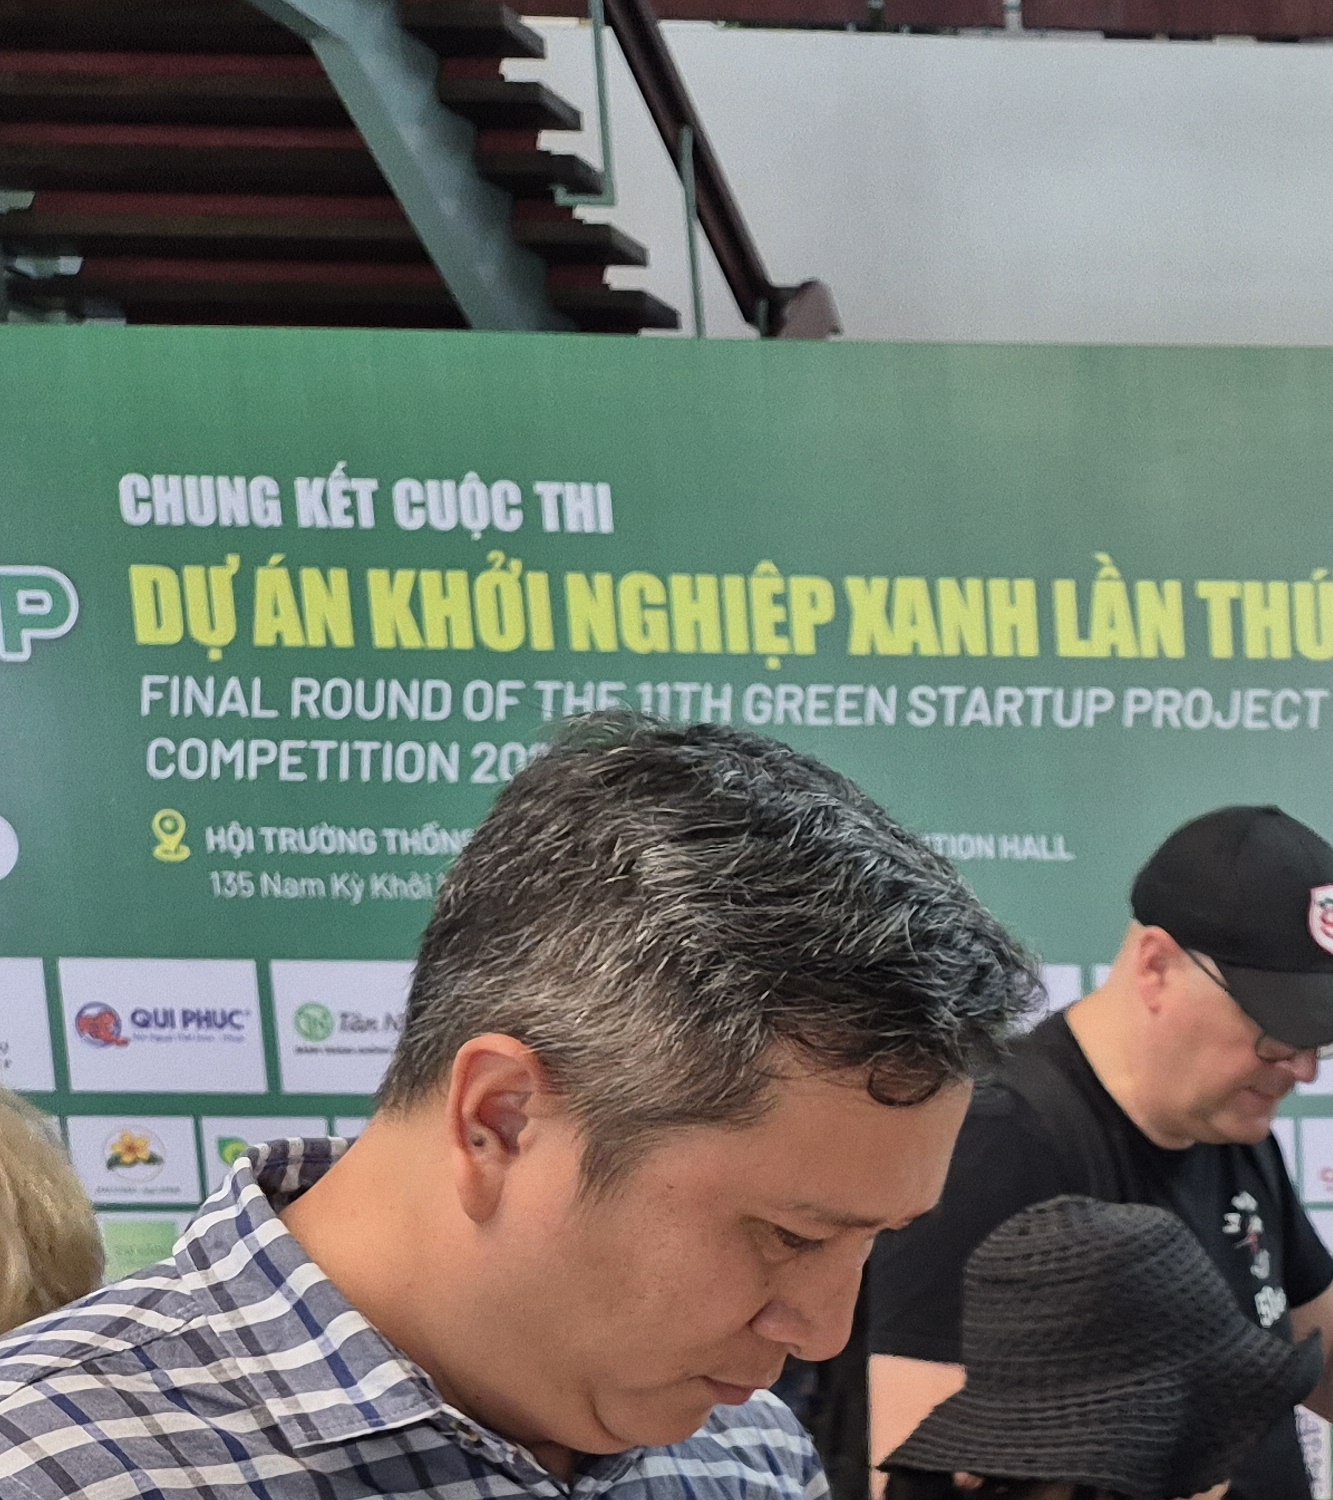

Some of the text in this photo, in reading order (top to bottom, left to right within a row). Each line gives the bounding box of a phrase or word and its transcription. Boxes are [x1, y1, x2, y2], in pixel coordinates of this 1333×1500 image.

[118, 460, 615, 540] CHUNG KẾT CUỘC THI
[128, 553, 241, 661] DỰ
[253, 553, 354, 648] ÁN
[368, 550, 556, 653] KHỞI
[566, 558, 836, 670] NGHIỆP
[847, 574, 1039, 657] XANH
[1054, 552, 1187, 659] LẦN
[140, 674, 278, 720] FINAL
[291, 677, 452, 722] ROUND
[462, 679, 526, 722] OF
[637, 682, 733, 724] 11TH
[742, 684, 897, 727] GREEN
[906, 686, 1114, 729] STARTUP
[1122, 688, 1330, 731] PROJECT
[146, 738, 460, 783] COMPETITION
[205, 820, 255, 859] HỘI
[258, 822, 377, 856] TRƯỜNG
[1000, 833, 1077, 861] HALL
[210, 870, 255, 898] 135
[260, 871, 325, 898] Nam
[330, 871, 365, 906] Kỳ
[131, 1009, 175, 1029] QUI
